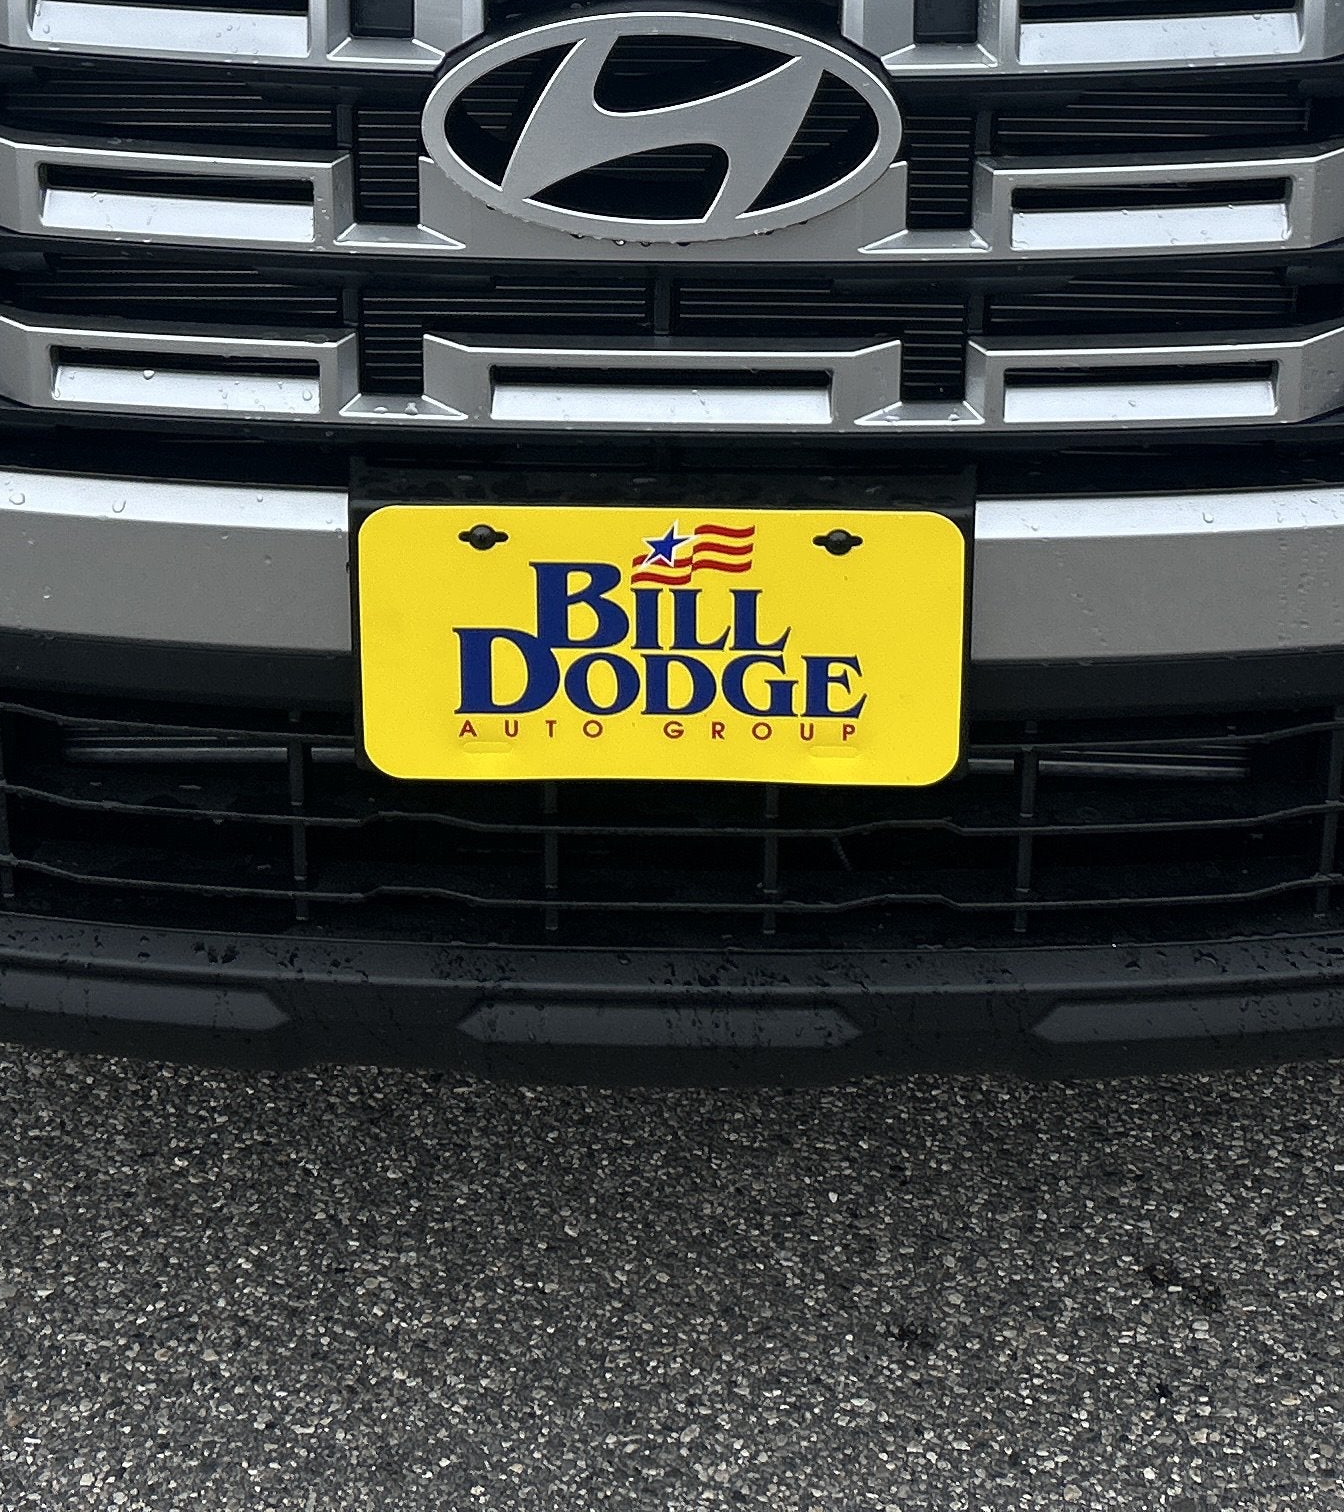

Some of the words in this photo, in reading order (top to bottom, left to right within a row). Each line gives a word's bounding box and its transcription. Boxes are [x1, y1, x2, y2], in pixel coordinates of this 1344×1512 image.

[529, 562, 791, 652] BILL
[453, 627, 868, 719] DODGE
[458, 719, 604, 740] AUTO
[663, 720, 857, 742] GROUP
